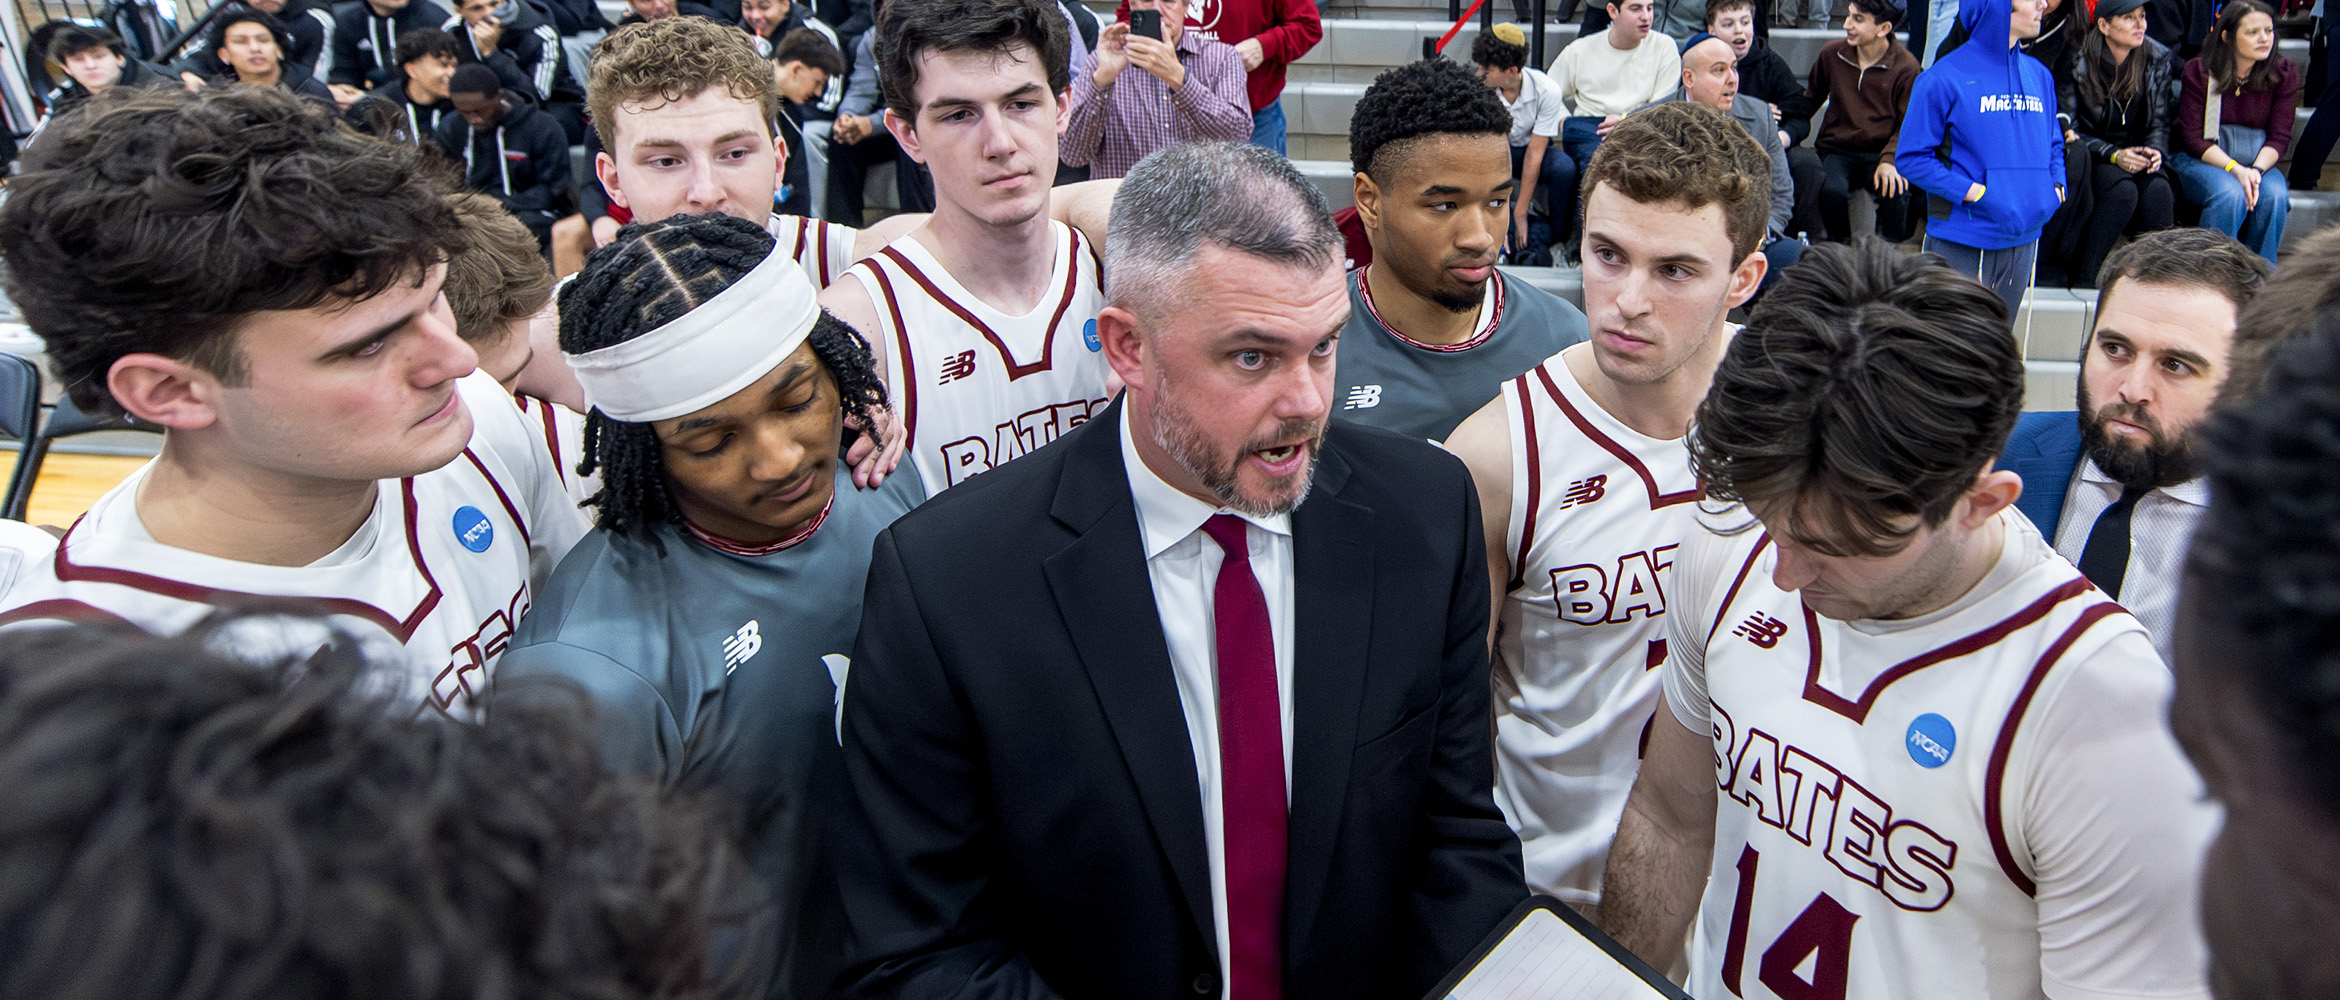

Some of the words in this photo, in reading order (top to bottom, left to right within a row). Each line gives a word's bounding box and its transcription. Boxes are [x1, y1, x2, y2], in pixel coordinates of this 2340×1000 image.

[463, 518, 492, 544] NCAA
[1910, 729, 1950, 763] NCAA
[1709, 696, 1958, 911] BATES
[1721, 841, 1862, 1000] 14
